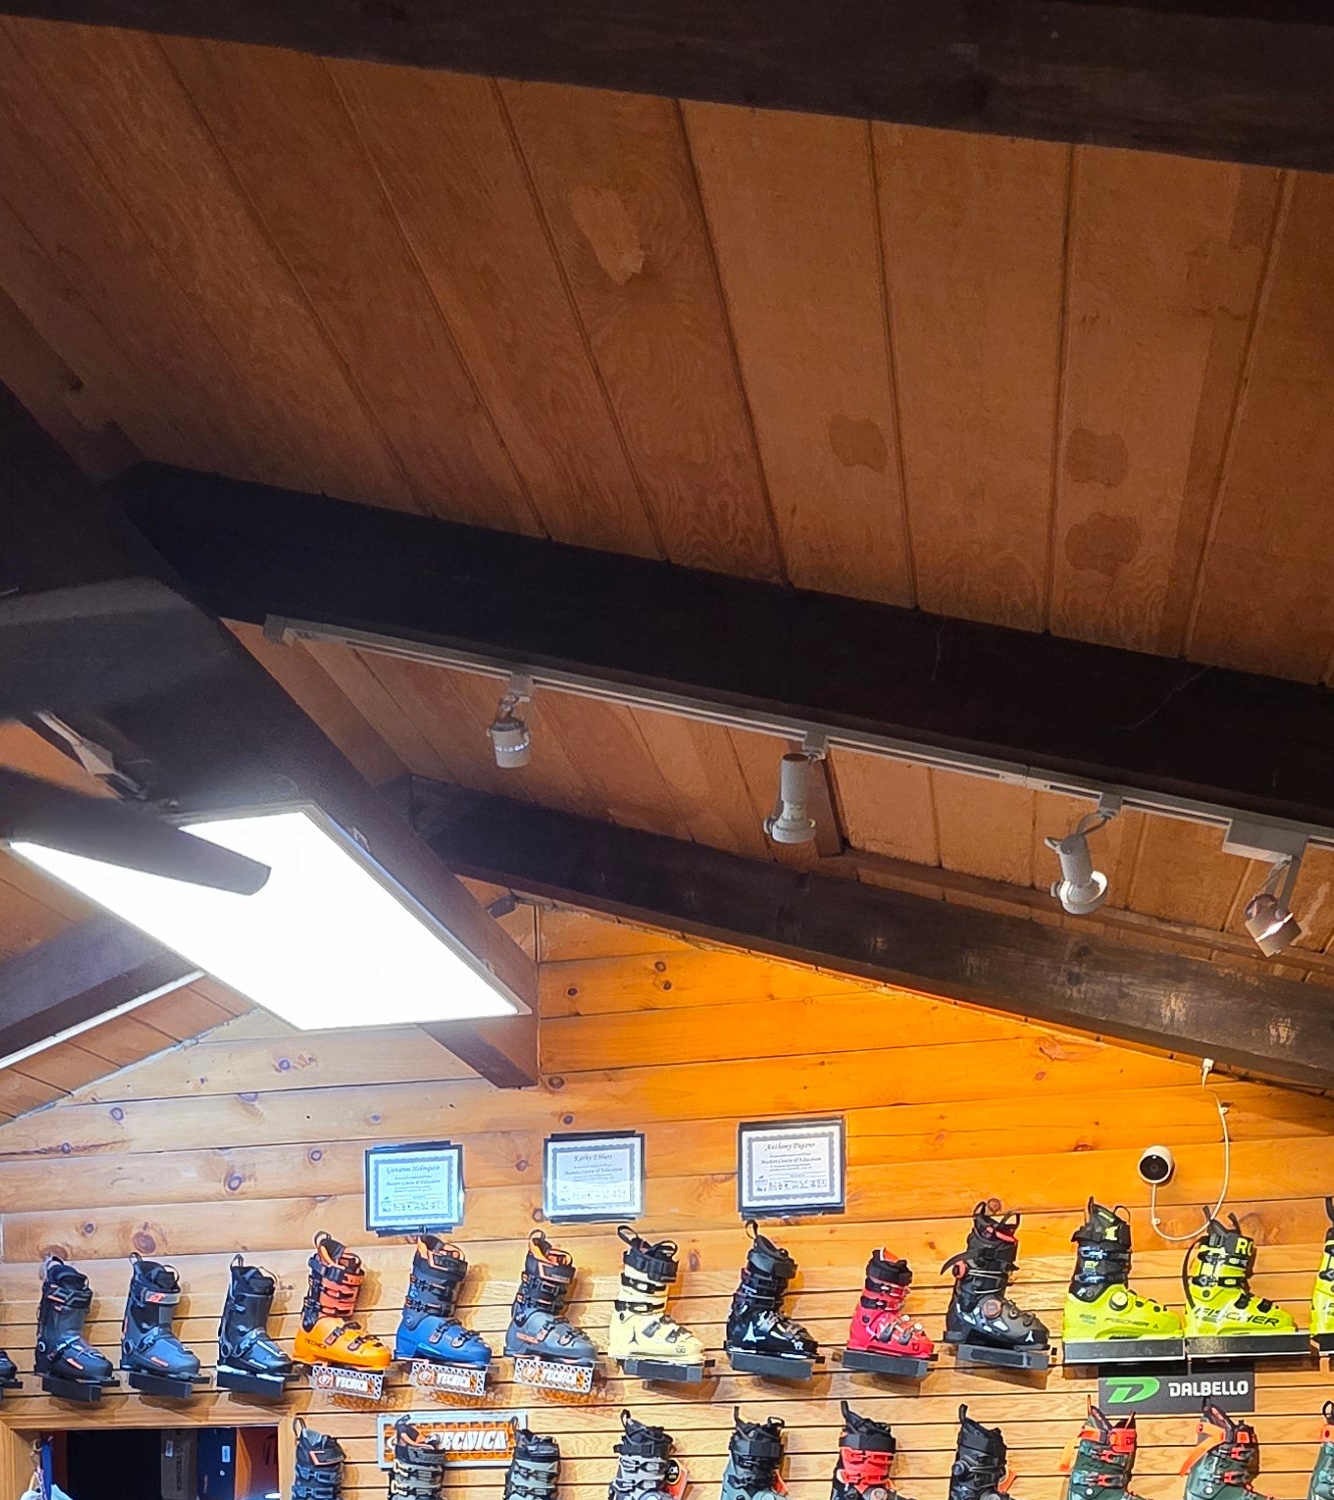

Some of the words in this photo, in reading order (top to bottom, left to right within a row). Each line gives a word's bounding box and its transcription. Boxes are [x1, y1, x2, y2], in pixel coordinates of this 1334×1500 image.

[1105, 1317, 1151, 1327] FISCHER
[1193, 1308, 1279, 1327] FISCHER
[1169, 1381, 1249, 1397] DALBELLO
